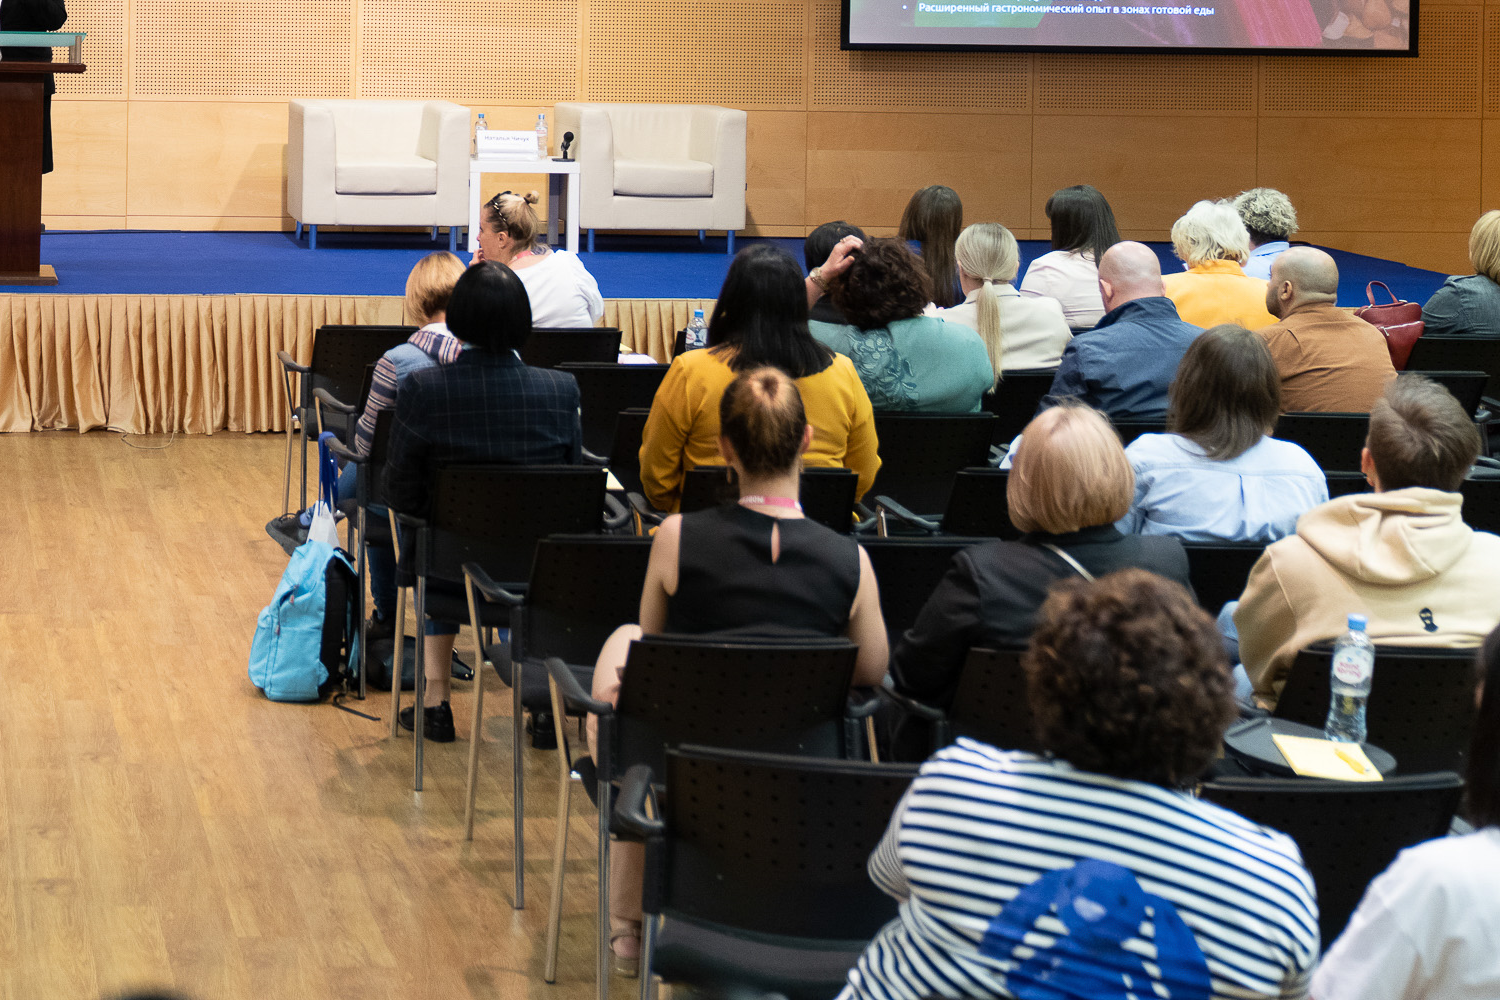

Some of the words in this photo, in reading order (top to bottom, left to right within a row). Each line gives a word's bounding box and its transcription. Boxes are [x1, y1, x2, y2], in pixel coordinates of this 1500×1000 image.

[918, 2, 989, 13] Расширенный
[990, 3, 1084, 14] гастрономический
[1151, 4, 1192, 13] готовой
[1193, 7, 1214, 15] еды
